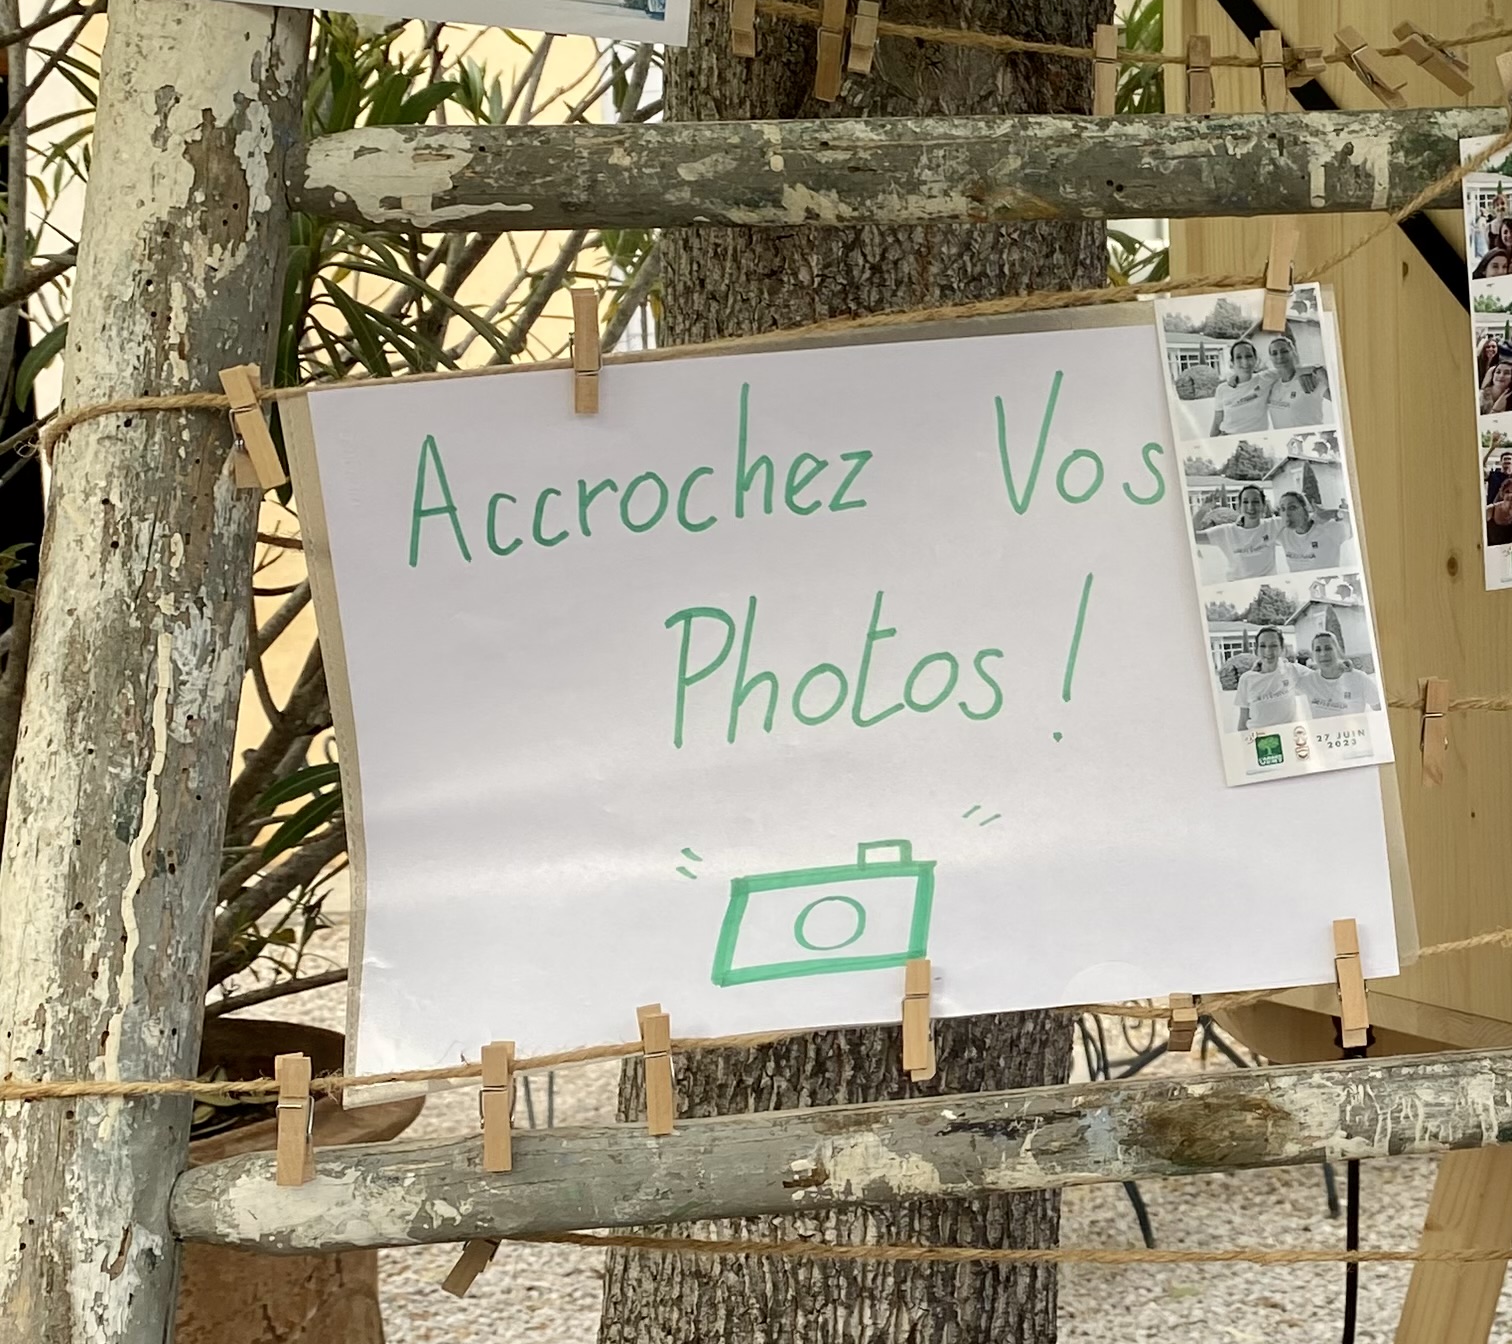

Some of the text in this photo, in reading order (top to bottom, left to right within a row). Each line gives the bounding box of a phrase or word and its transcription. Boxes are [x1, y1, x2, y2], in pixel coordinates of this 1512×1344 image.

[409, 370, 1166, 567] Accrochez Vos
[665, 573, 1093, 748] Photos !
[1316, 729, 1366, 742] 27 JUIN
[1327, 739, 1357, 749] 2023
